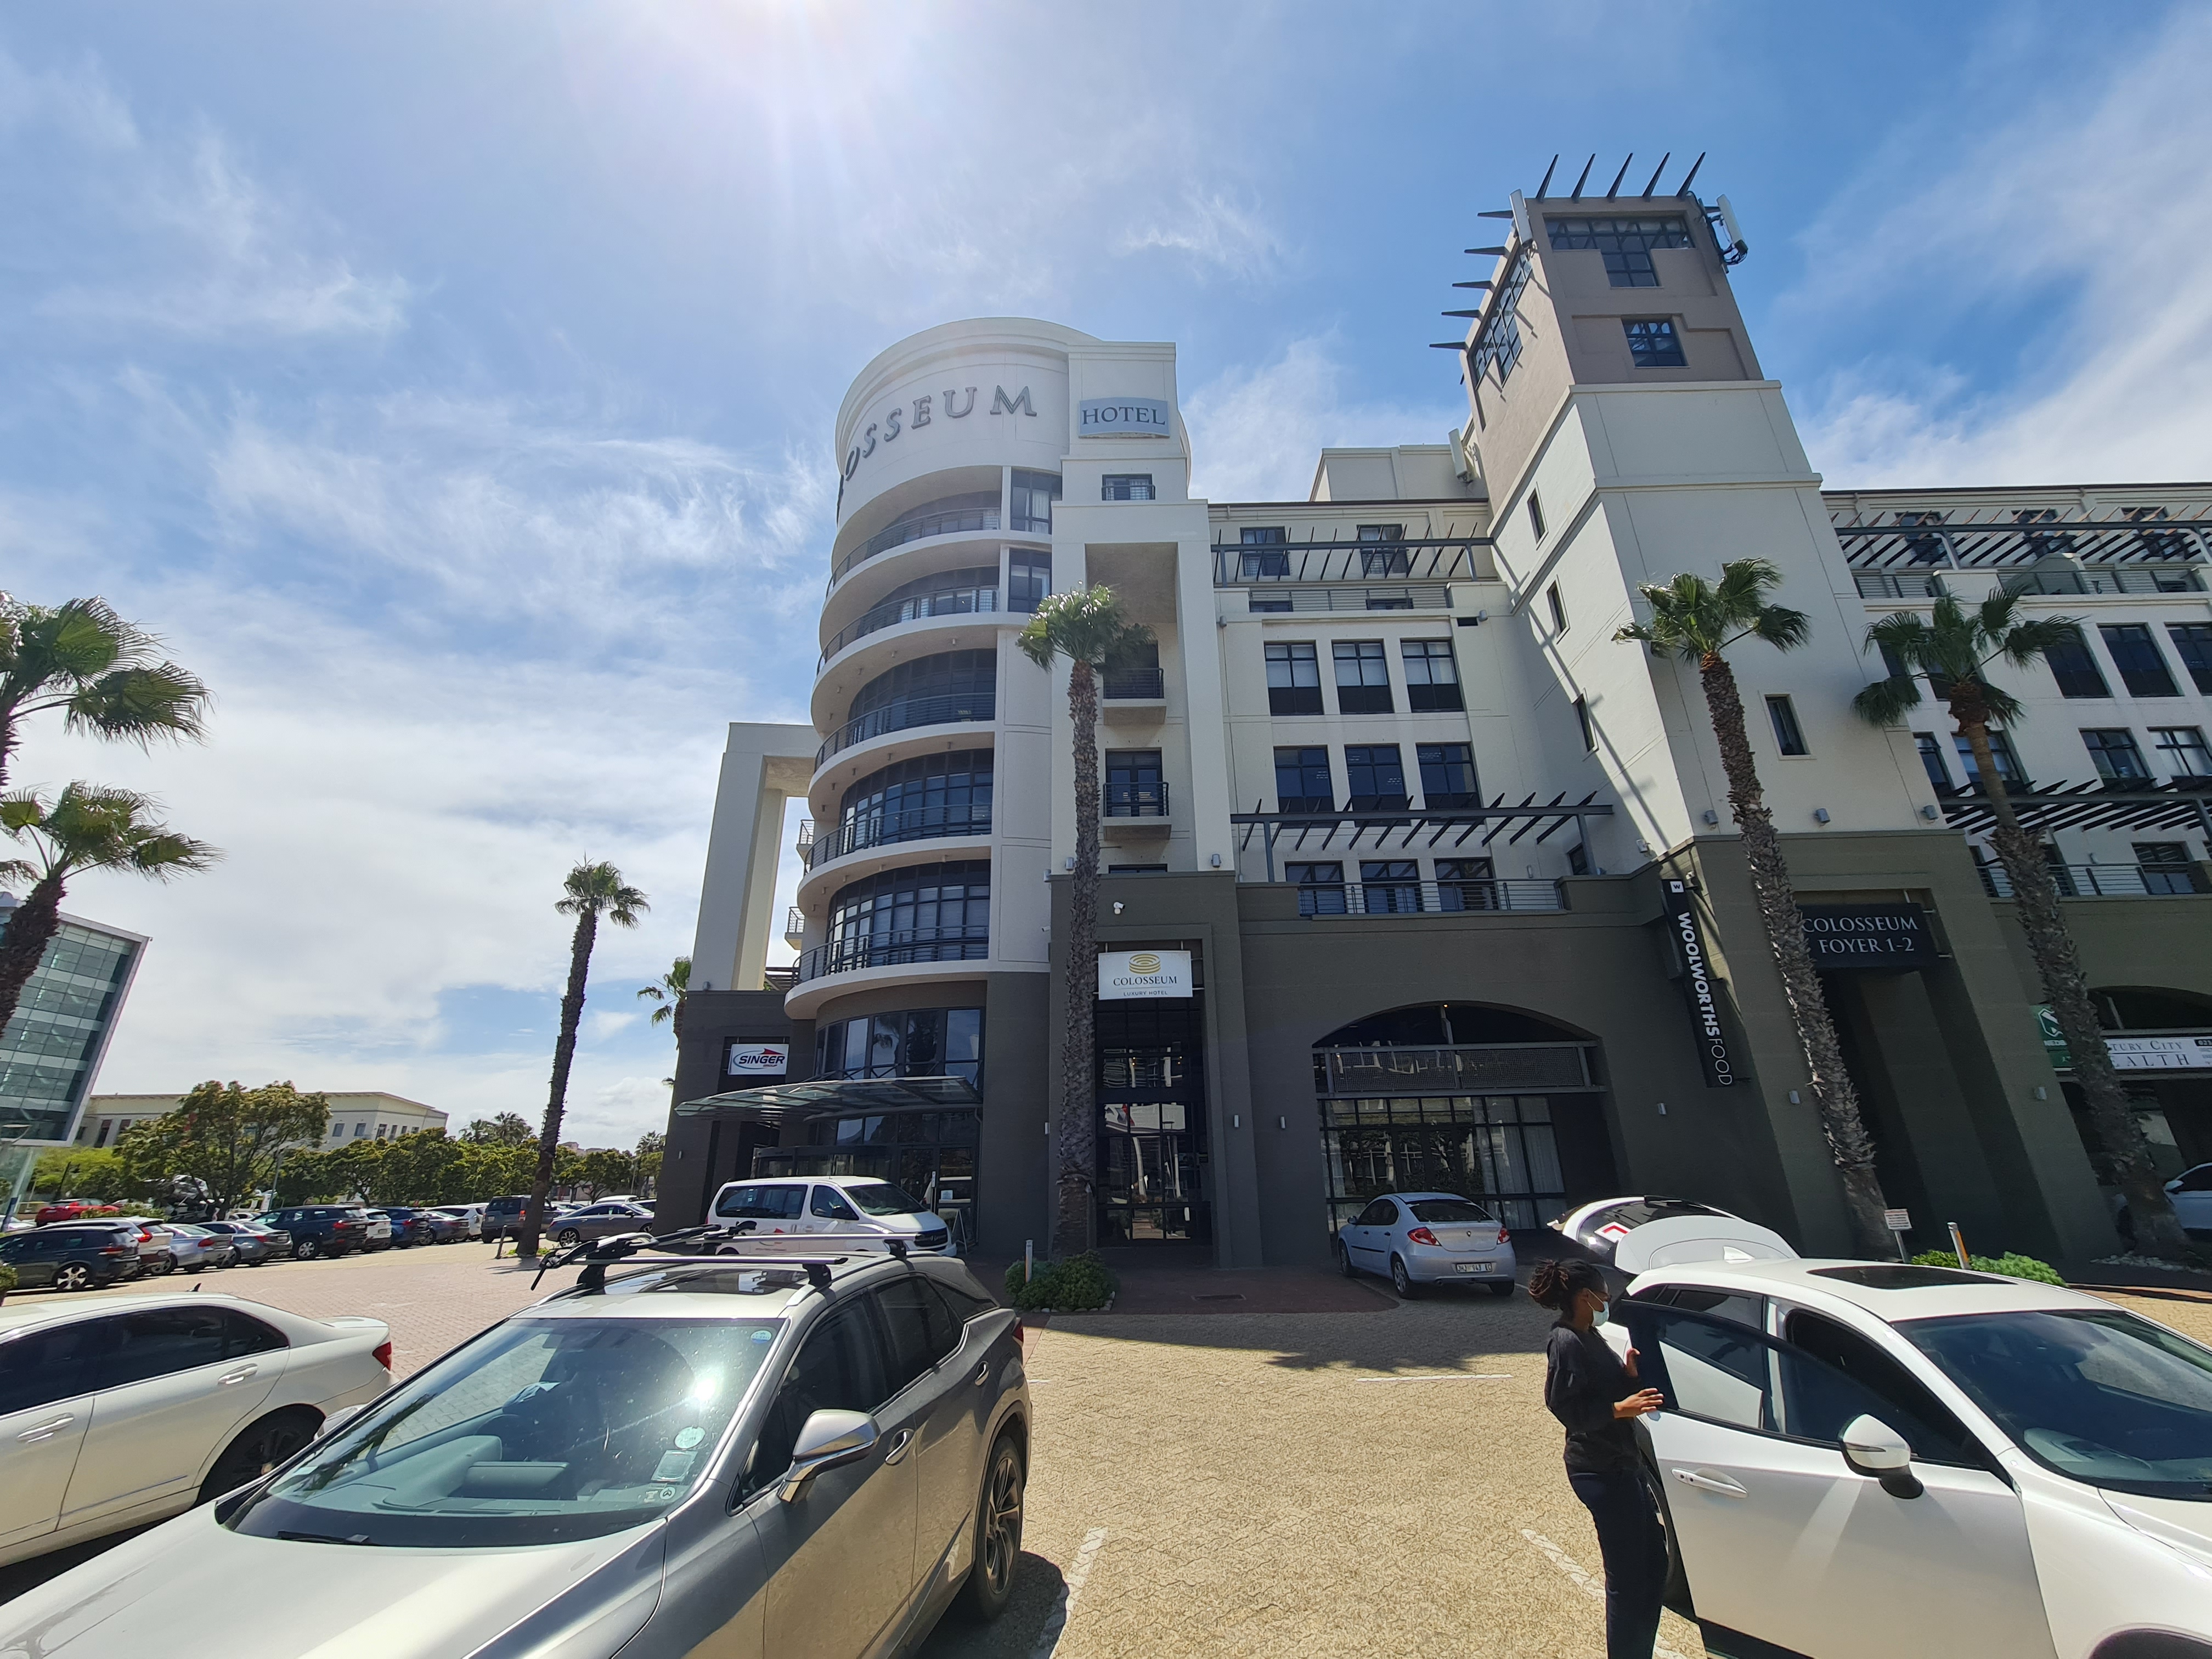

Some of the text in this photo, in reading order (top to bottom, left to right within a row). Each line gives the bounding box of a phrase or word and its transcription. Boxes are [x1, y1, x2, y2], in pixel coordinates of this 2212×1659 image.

[1082, 407, 1165, 425] HOTEL
[845, 385, 1037, 481] OSSEUM
[1802, 916, 1918, 933] COLOSSEUM
[1818, 937, 1915, 953] FOYER 1-2
[1113, 976, 1177, 986] COLOSSEUM
[1678, 912, 1733, 1085] WOOLWORTHS FOOD
[2111, 1043, 2142, 1051] TURY
[738, 1056, 785, 1064] SINGER
[2113, 1054, 2190, 1067] ALTH
